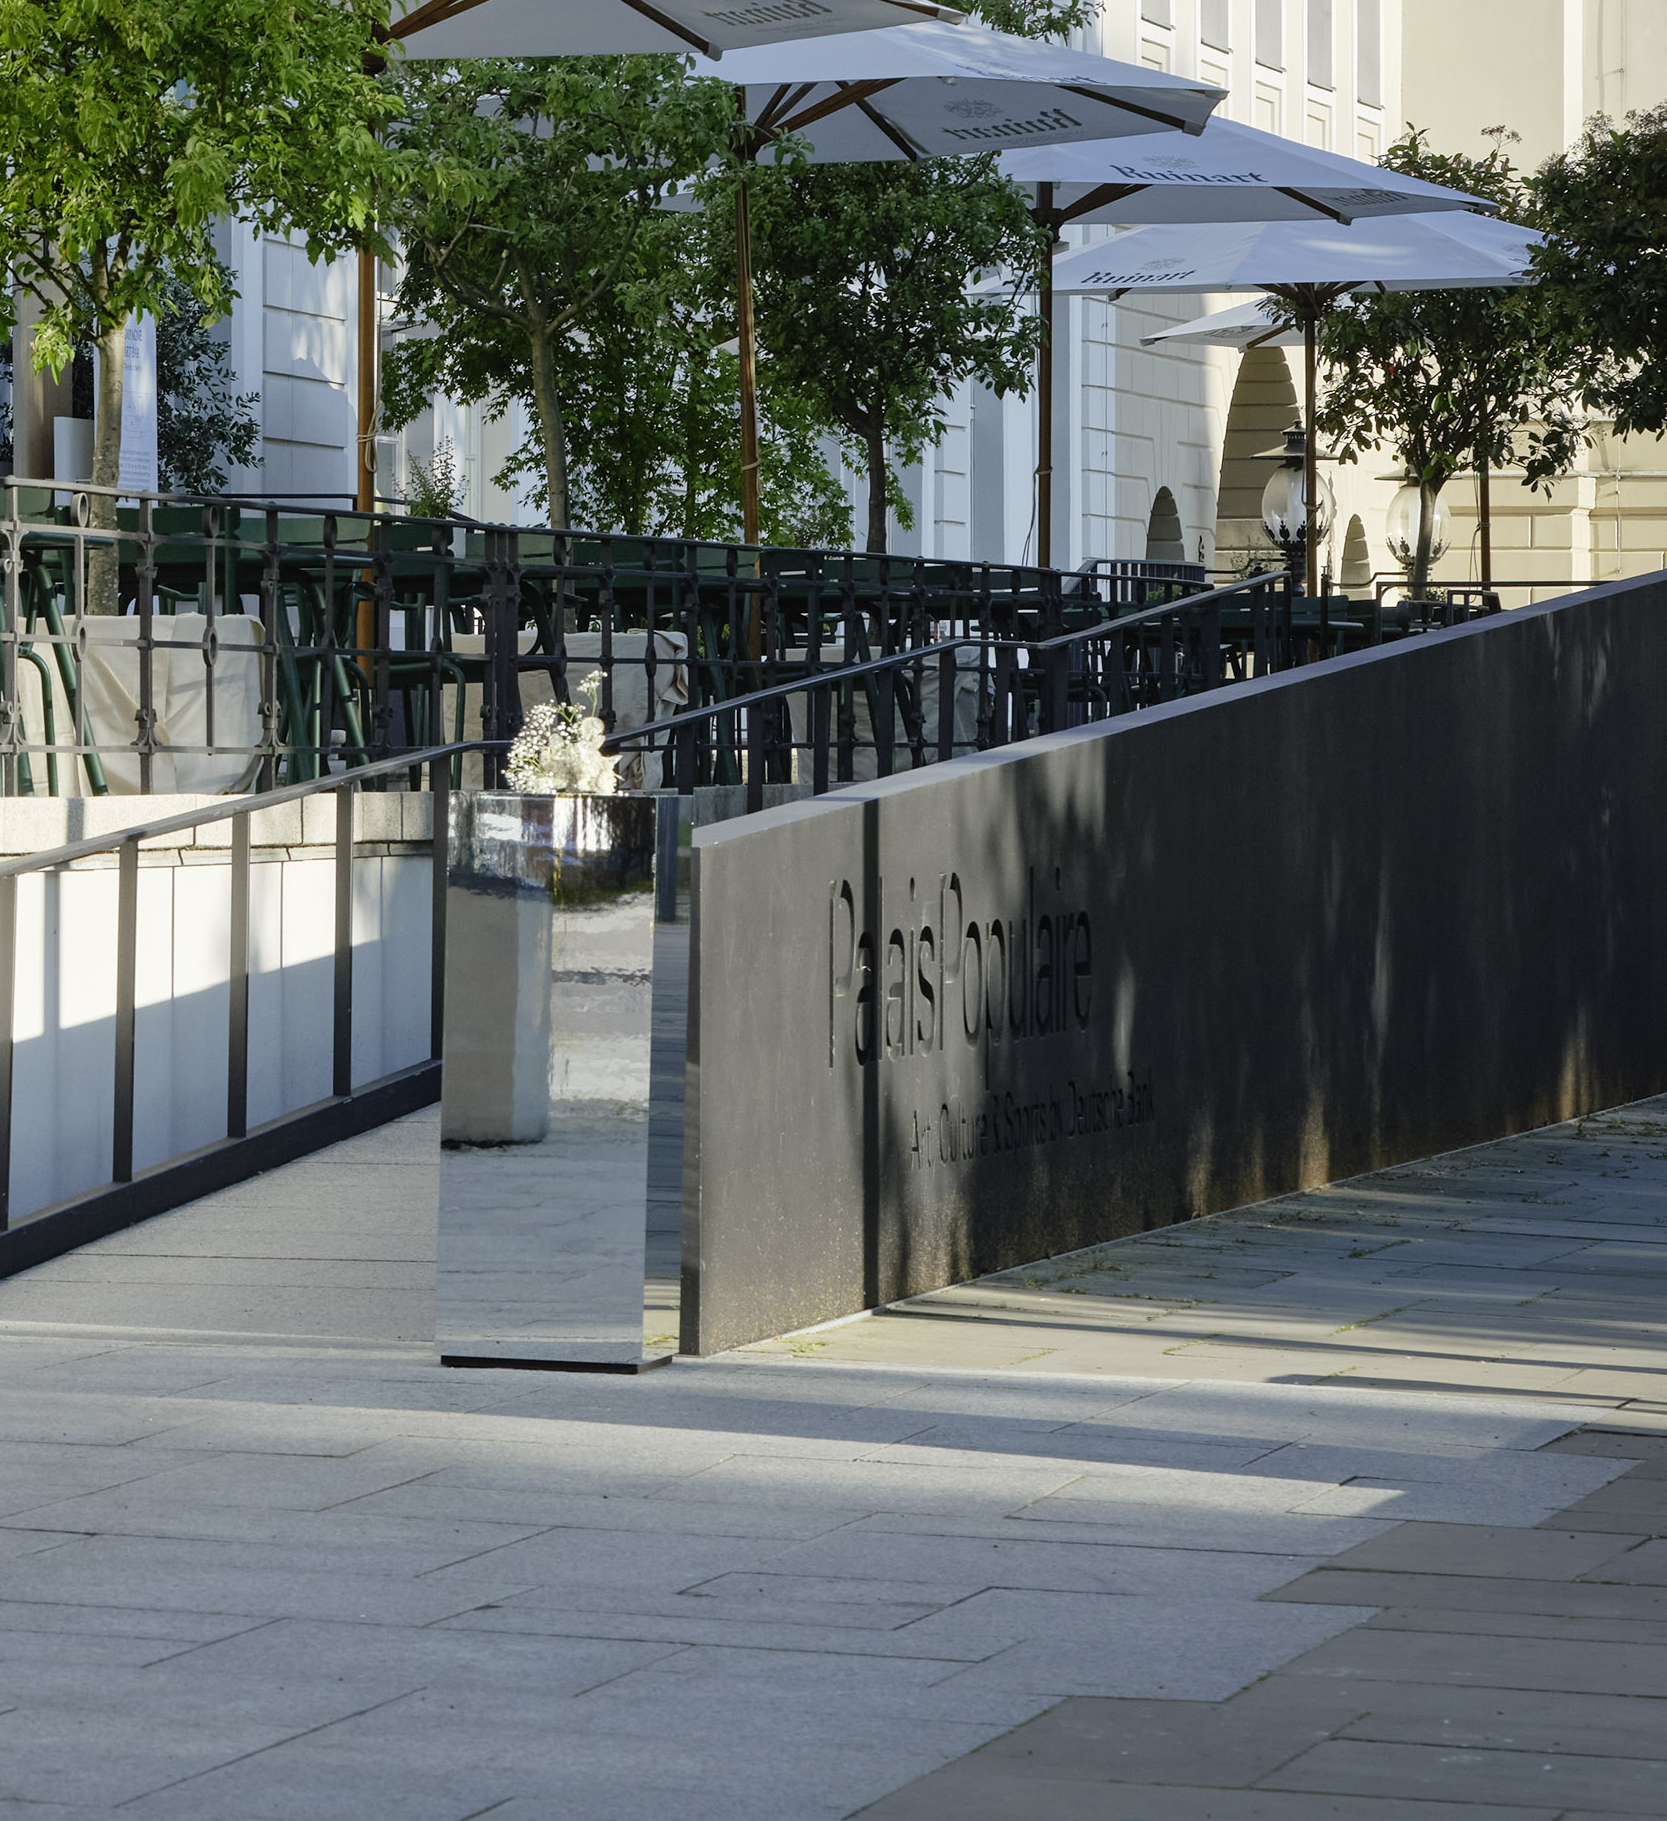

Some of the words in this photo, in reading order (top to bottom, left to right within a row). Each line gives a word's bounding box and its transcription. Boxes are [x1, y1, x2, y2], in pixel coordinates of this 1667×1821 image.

[1109, 164, 1269, 183] Ruinart
[1080, 270, 1197, 284] Ruinart
[828, 866, 1093, 1092] PalaisPopulaire
[939, 1101, 988, 1164] Culture
[1004, 1089, 1047, 1163] Sports
[1068, 1079, 1124, 1139] Deutsche
[1128, 1065, 1156, 1127] Bank
